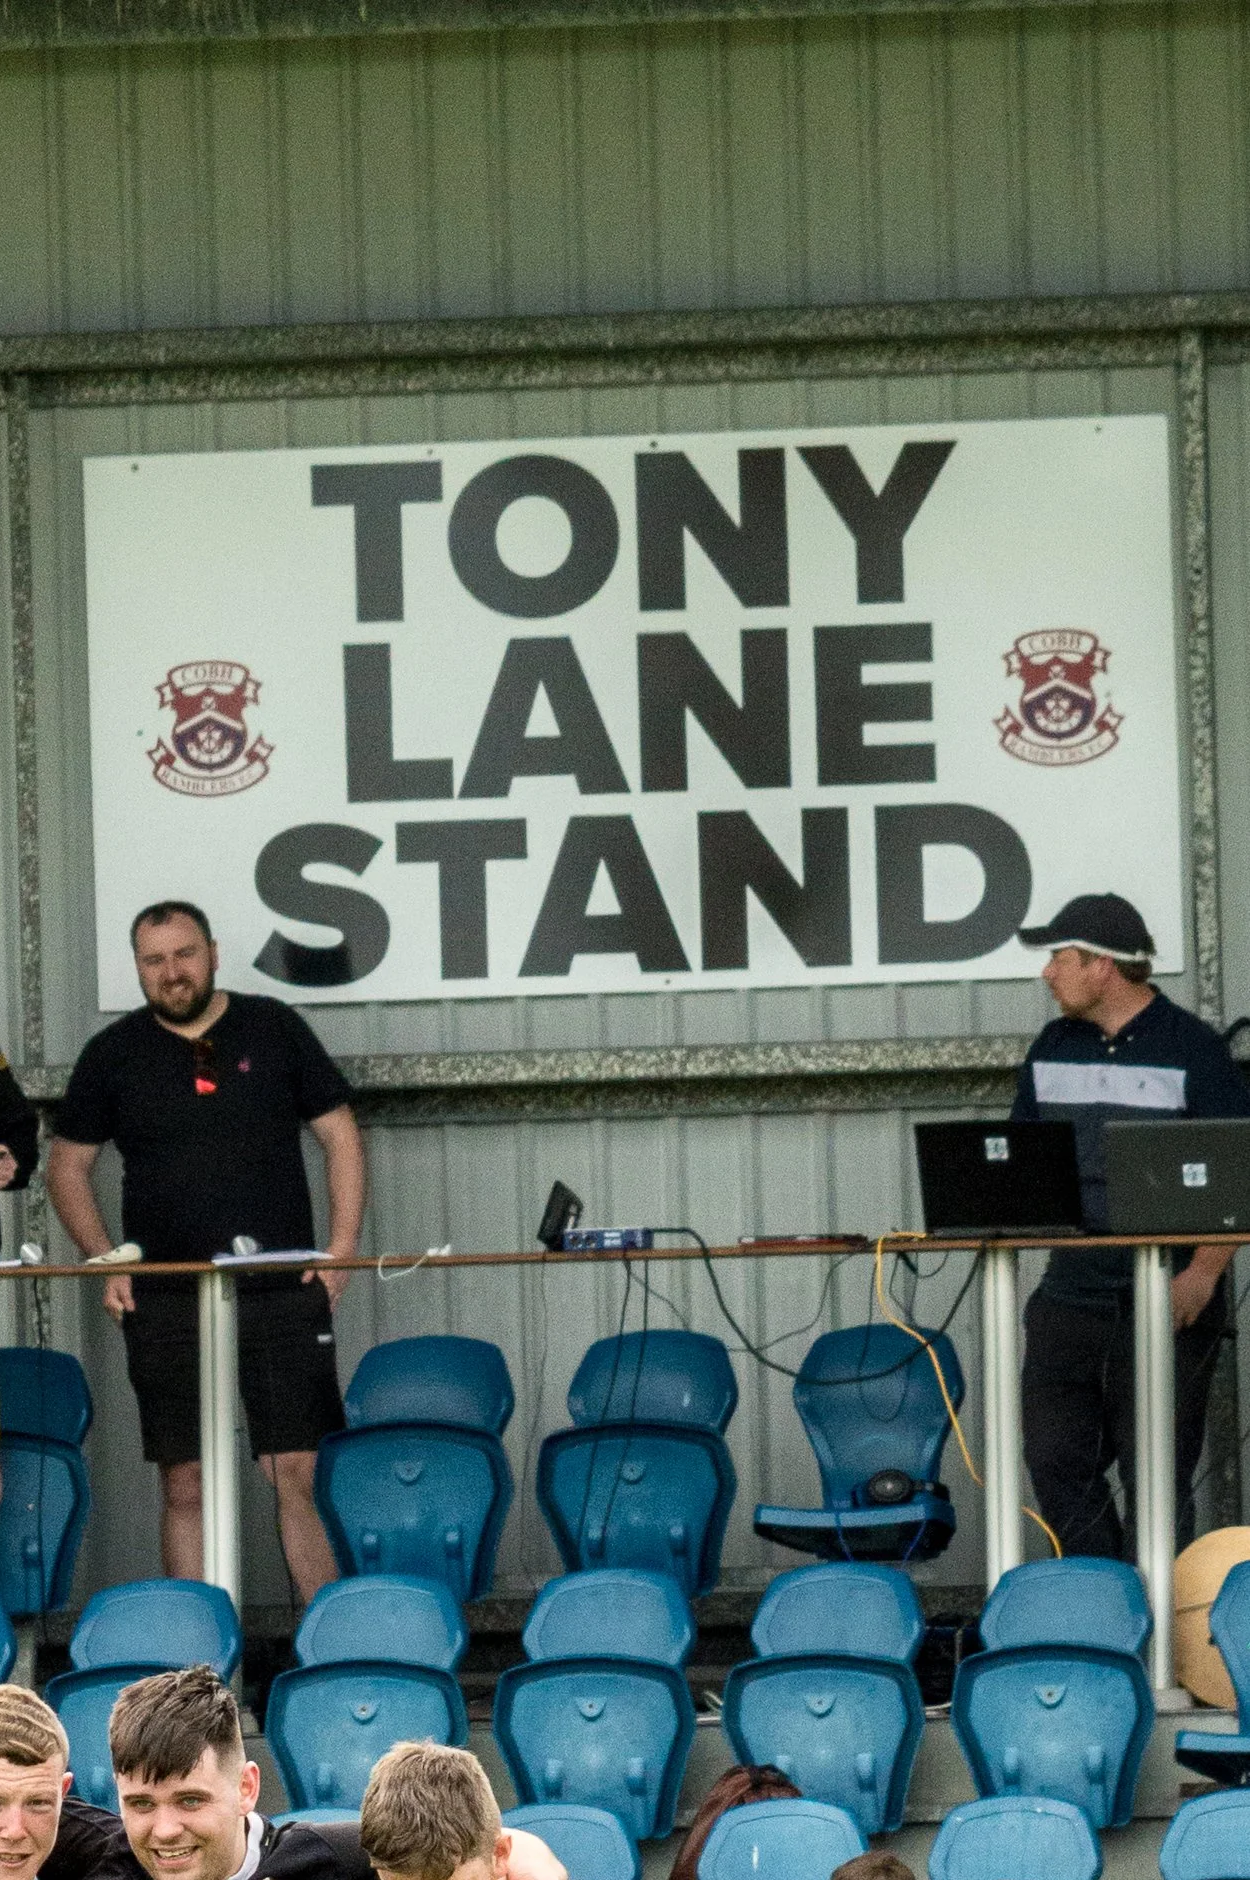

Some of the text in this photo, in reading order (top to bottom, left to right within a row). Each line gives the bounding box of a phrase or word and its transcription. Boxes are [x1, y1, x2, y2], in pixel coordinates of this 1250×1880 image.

[311, 440, 957, 624] TONY
[343, 622, 937, 804] LANE
[252, 802, 1031, 988] STAND
